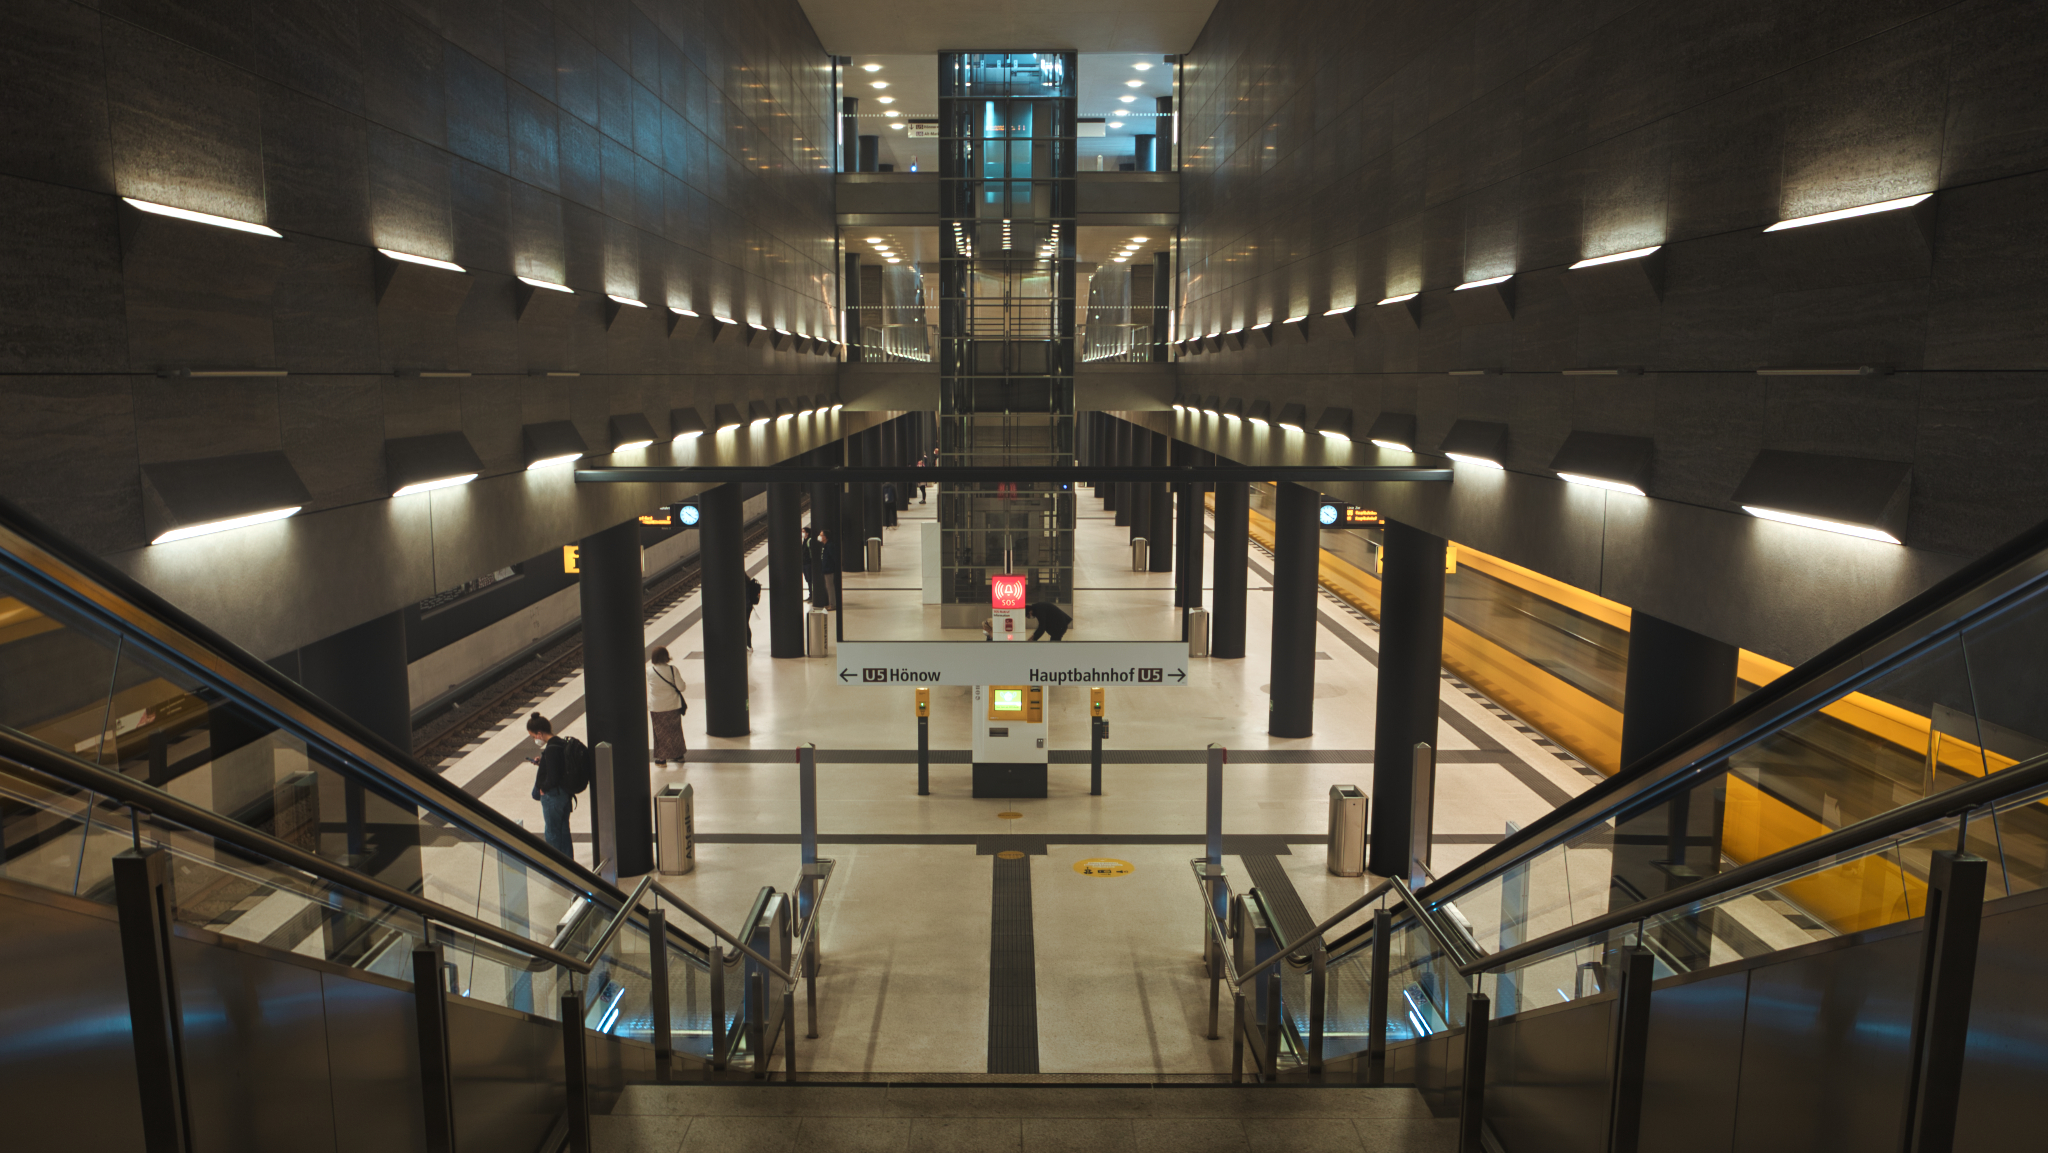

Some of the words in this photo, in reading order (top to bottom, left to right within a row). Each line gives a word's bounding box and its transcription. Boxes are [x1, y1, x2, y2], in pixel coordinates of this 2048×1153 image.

[864, 668, 886, 682] U5
[890, 668, 941, 682] Hönow
[1029, 667, 1135, 685] Hauptbahnhof
[1140, 668, 1162, 682] U5
